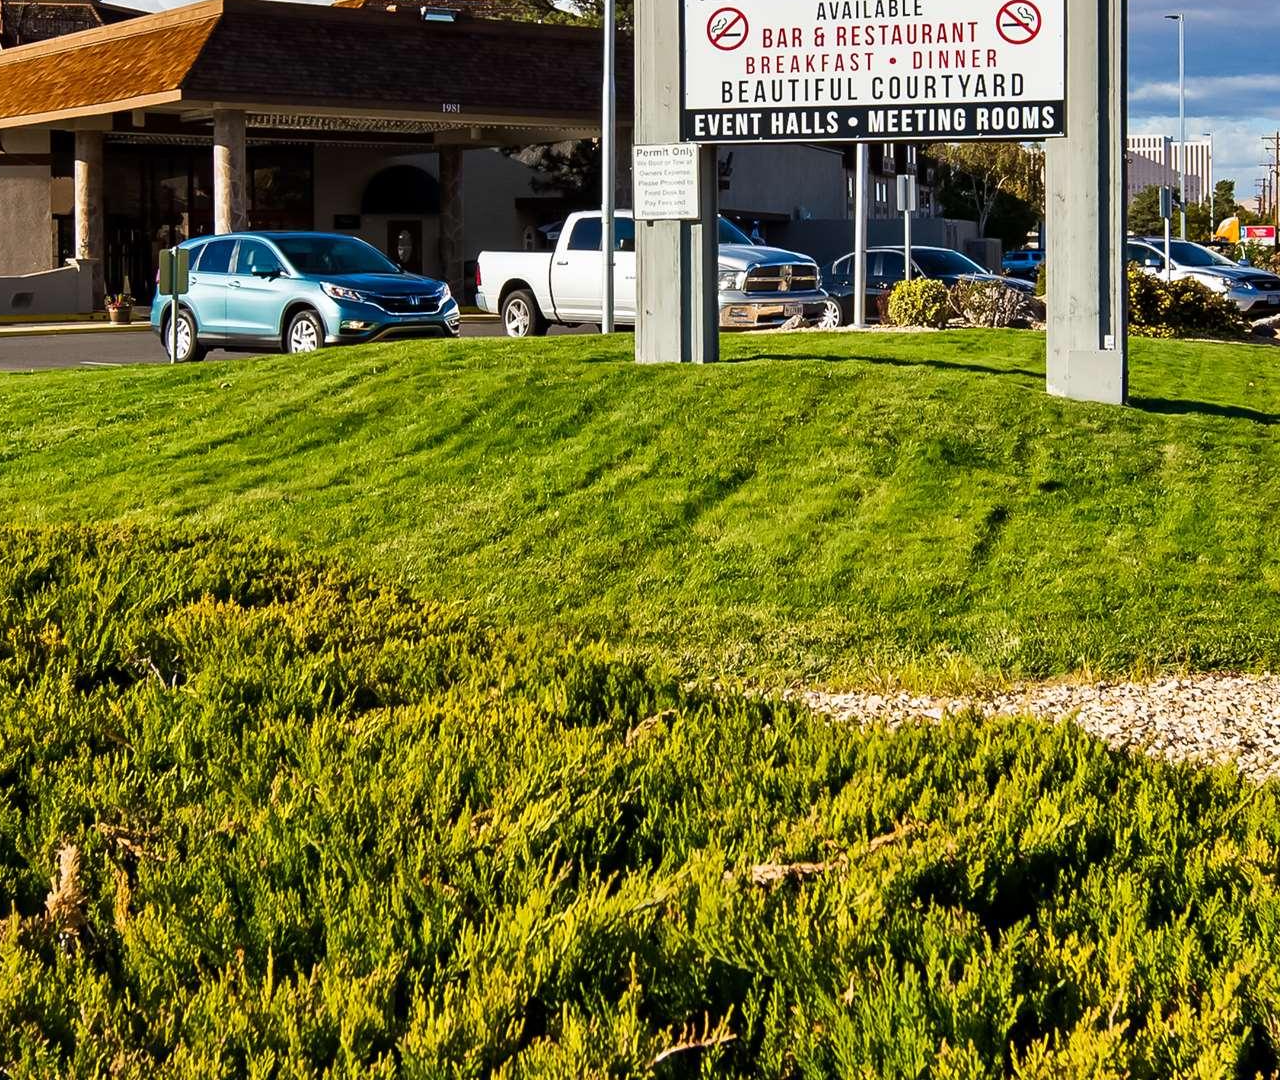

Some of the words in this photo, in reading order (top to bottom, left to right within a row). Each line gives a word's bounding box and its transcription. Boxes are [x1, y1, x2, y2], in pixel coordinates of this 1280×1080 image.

[762, 26, 804, 49] BAR
[814, 25, 826, 47] &
[836, 21, 979, 47] RESTAURANT
[745, 52, 875, 75] BREAKFAST
[912, 48, 998, 70] DINNER
[721, 75, 858, 104] BEAUTIFUL
[871, 72, 1025, 101] COURTYARD
[442, 103, 460, 113] 1981
[694, 112, 762, 137] EVENT
[771, 110, 839, 135] HALLS
[868, 107, 967, 133] MEETING
[976, 105, 1055, 131] ROOMS
[636, 148, 669, 157] Permit
[672, 147, 695, 157] Only
